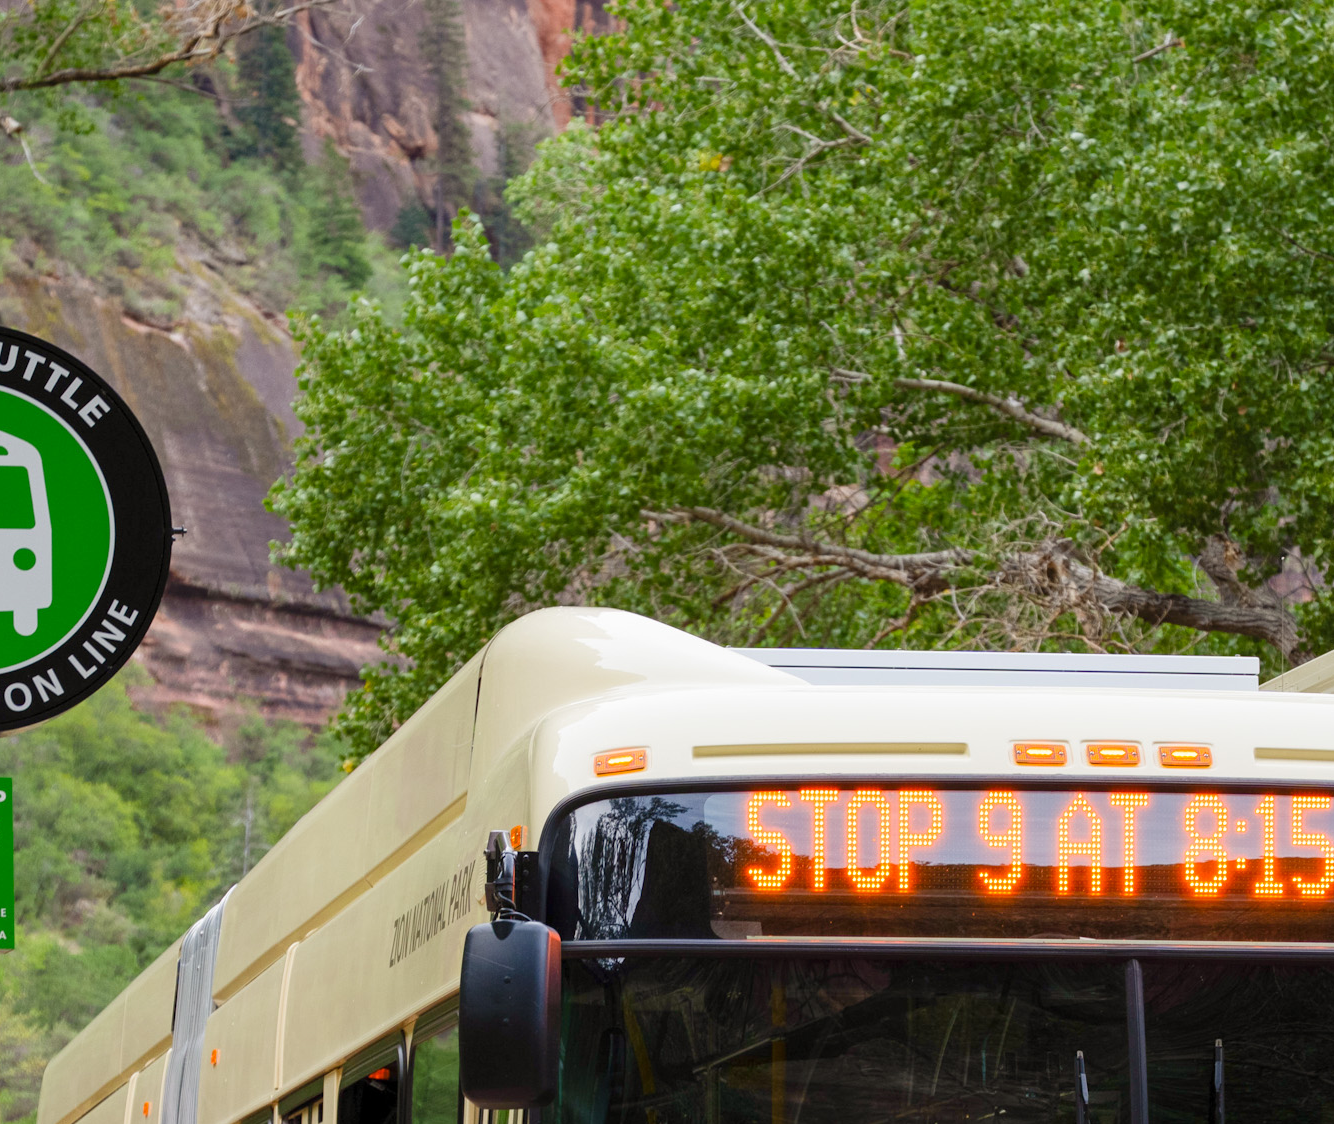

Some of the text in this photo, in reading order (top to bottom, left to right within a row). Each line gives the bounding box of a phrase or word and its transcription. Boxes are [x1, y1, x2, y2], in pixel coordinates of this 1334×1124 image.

[67, 599, 139, 680] LINE
[746, 789, 944, 892] STOP
[977, 791, 1025, 894] 9
[1056, 792, 1150, 895] AT
[409, 879, 449, 955] NATIONAL
[447, 860, 476, 926] PARK
